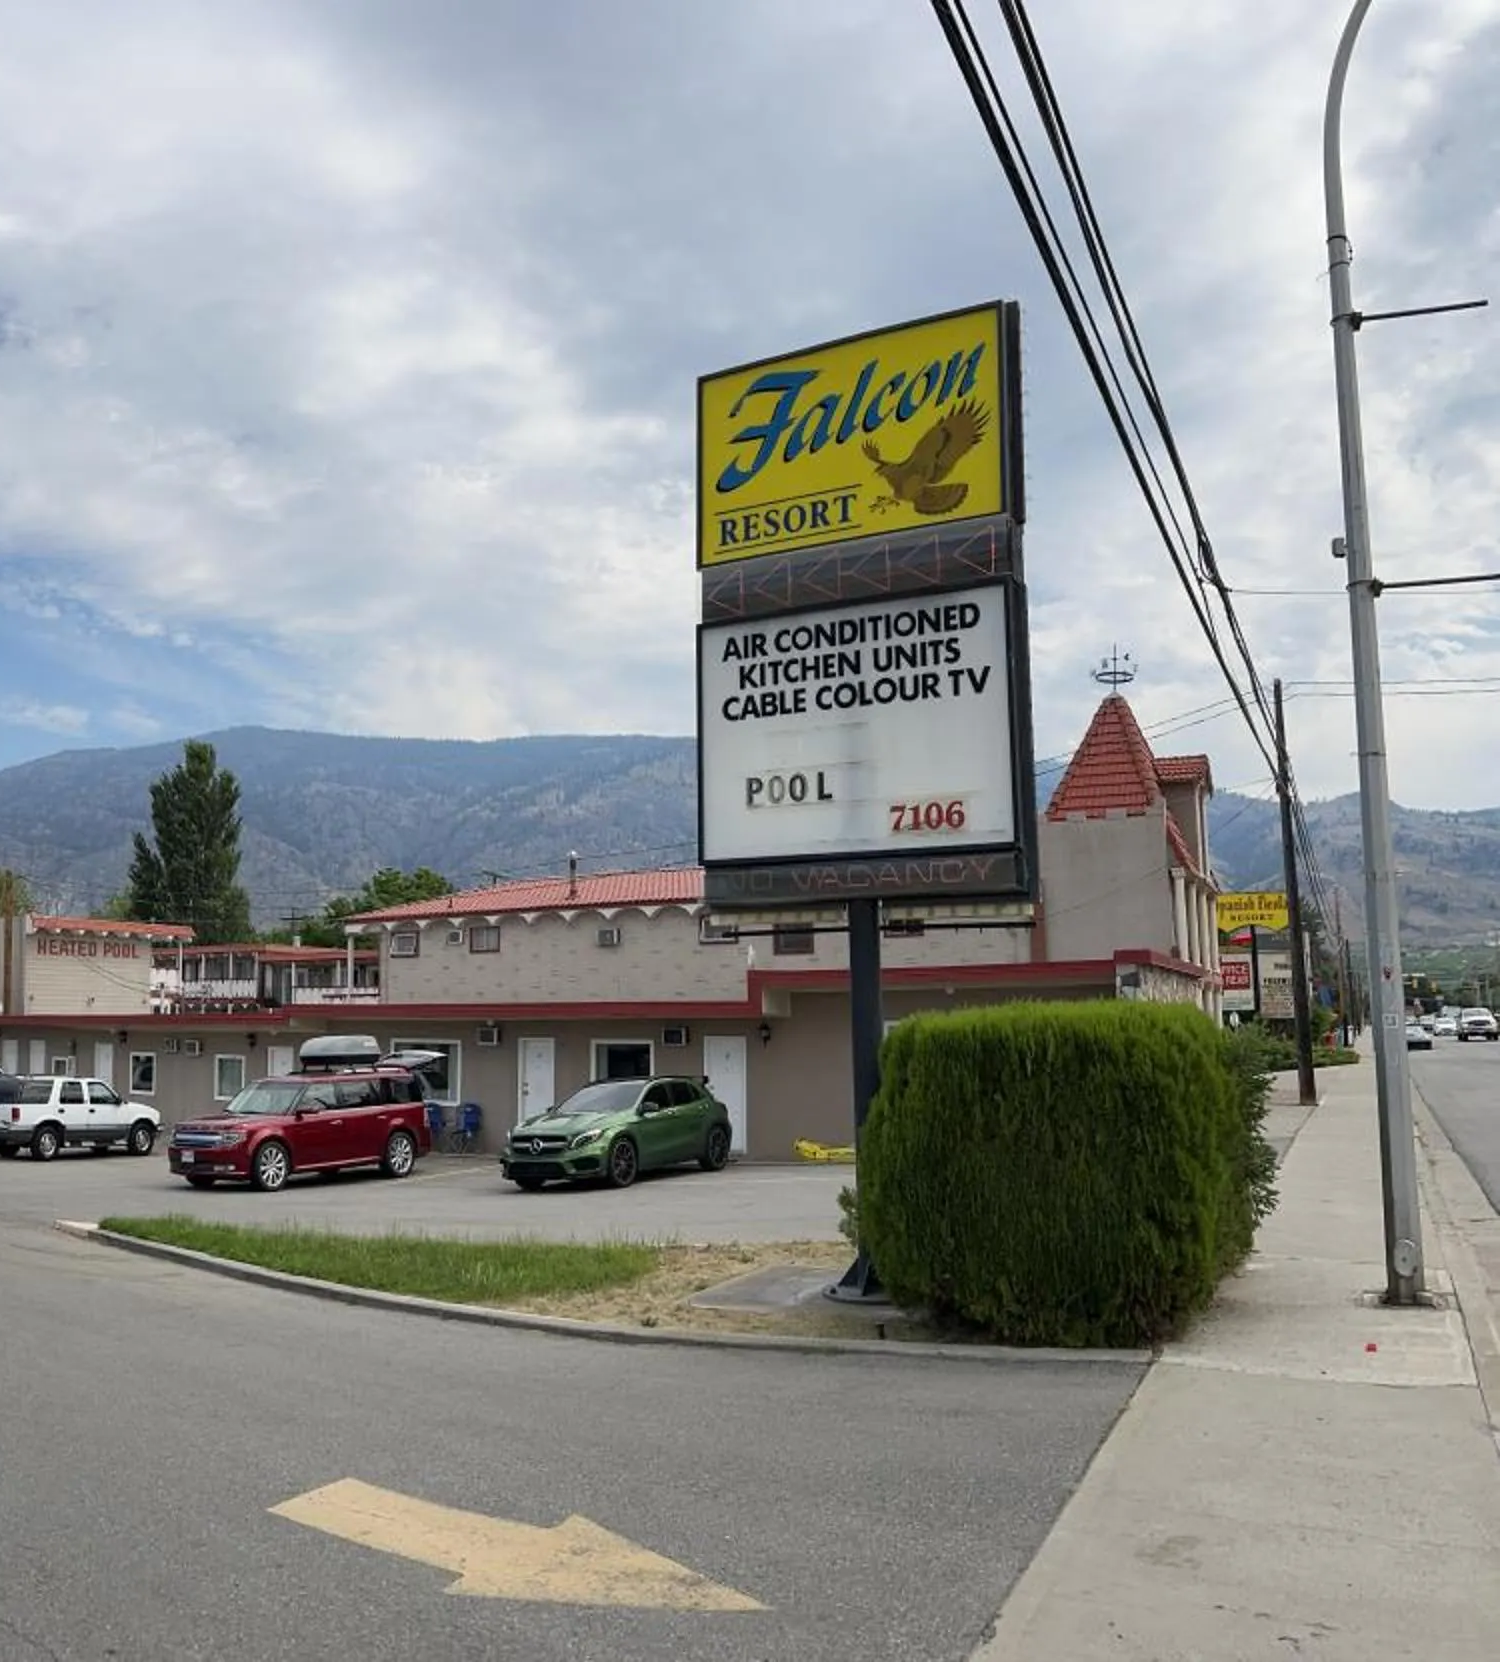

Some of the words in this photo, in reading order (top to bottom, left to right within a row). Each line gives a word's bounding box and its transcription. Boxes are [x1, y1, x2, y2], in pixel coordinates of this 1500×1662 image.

[715, 340, 987, 495] Falcon
[718, 494, 858, 547] RESORT
[721, 632, 768, 662] AIR
[773, 602, 981, 654] CONDITIONED
[739, 650, 861, 690] KITCHEN
[872, 637, 961, 672] UNITS
[721, 688, 807, 721] CABLE
[815, 672, 940, 710] COLOUR
[948, 665, 991, 697] TV
[745, 771, 833, 808] POOL
[889, 800, 966, 833] 7106
[791, 857, 996, 891] VACANCY
[37, 939, 97, 958] HEATED
[103, 941, 140, 959] POOL
